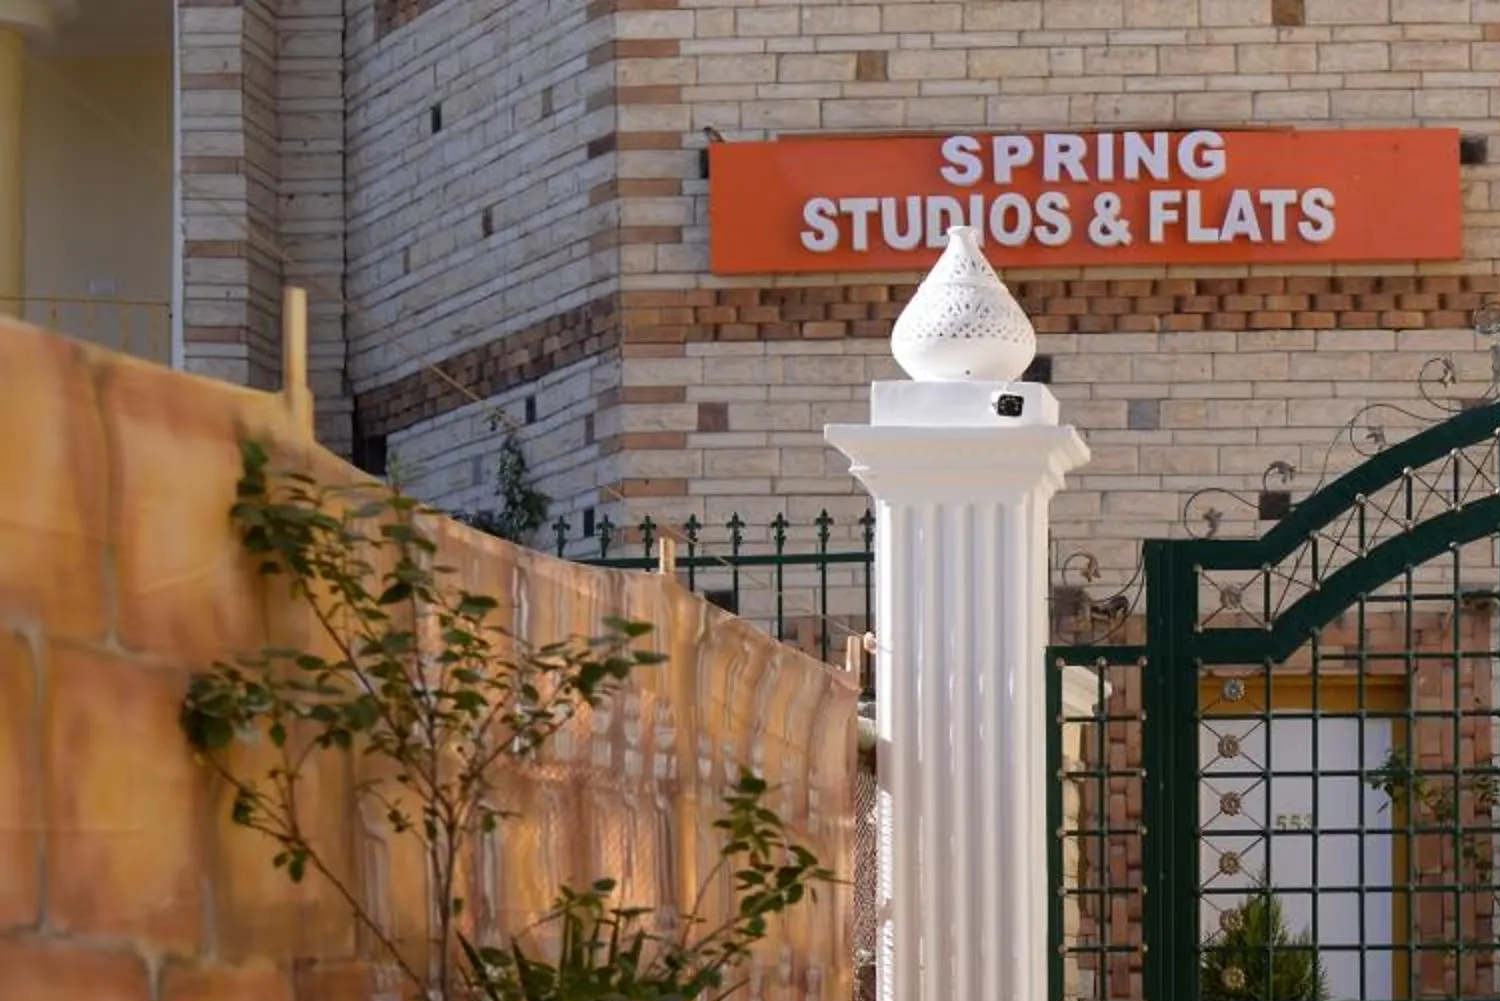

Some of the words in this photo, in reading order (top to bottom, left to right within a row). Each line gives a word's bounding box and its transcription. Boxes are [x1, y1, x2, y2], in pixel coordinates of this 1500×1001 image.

[939, 130, 1227, 187] SPRING
[801, 191, 1072, 252] STUDIOS
[1087, 192, 1133, 247] &
[1148, 187, 1337, 244] FLATS
